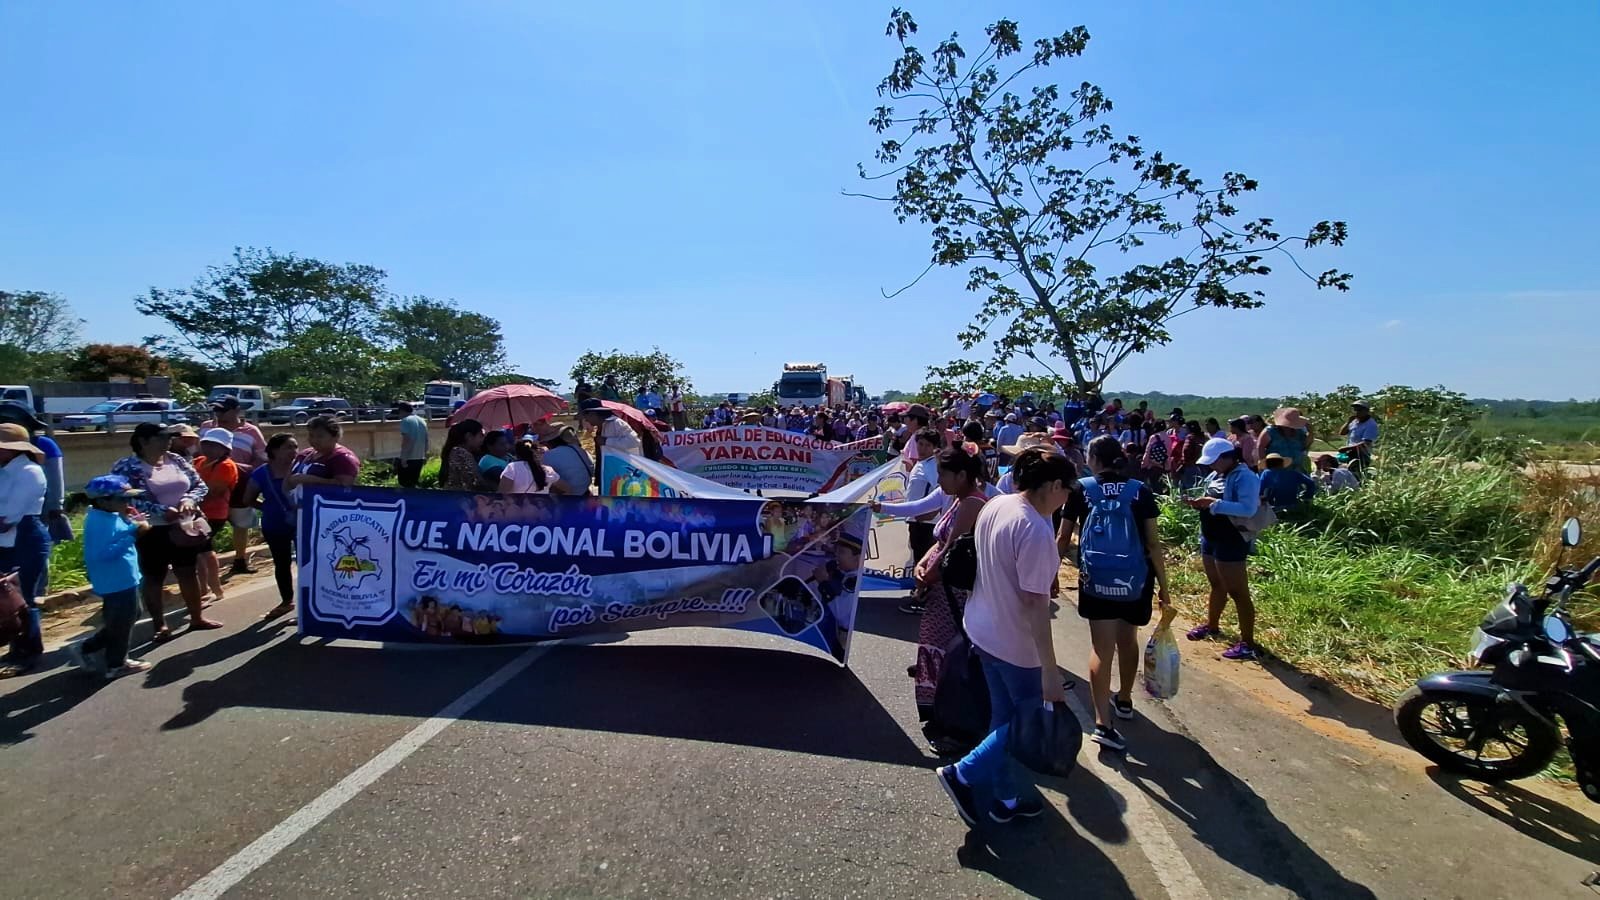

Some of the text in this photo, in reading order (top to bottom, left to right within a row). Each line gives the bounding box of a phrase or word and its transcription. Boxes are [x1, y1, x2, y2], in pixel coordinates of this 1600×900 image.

[674, 429, 740, 446] DISTRITAL
[744, 429, 762, 442] DE
[700, 445, 812, 464] YAPACANI
[321, 513, 389, 543] UNIDAD EDUCATIVA
[404, 519, 449, 550] U.E.
[457, 523, 614, 557] NACIONAL
[624, 530, 754, 563] BOLIVIA
[412, 559, 592, 595] En mi Corazón
[551, 605, 594, 631] por
